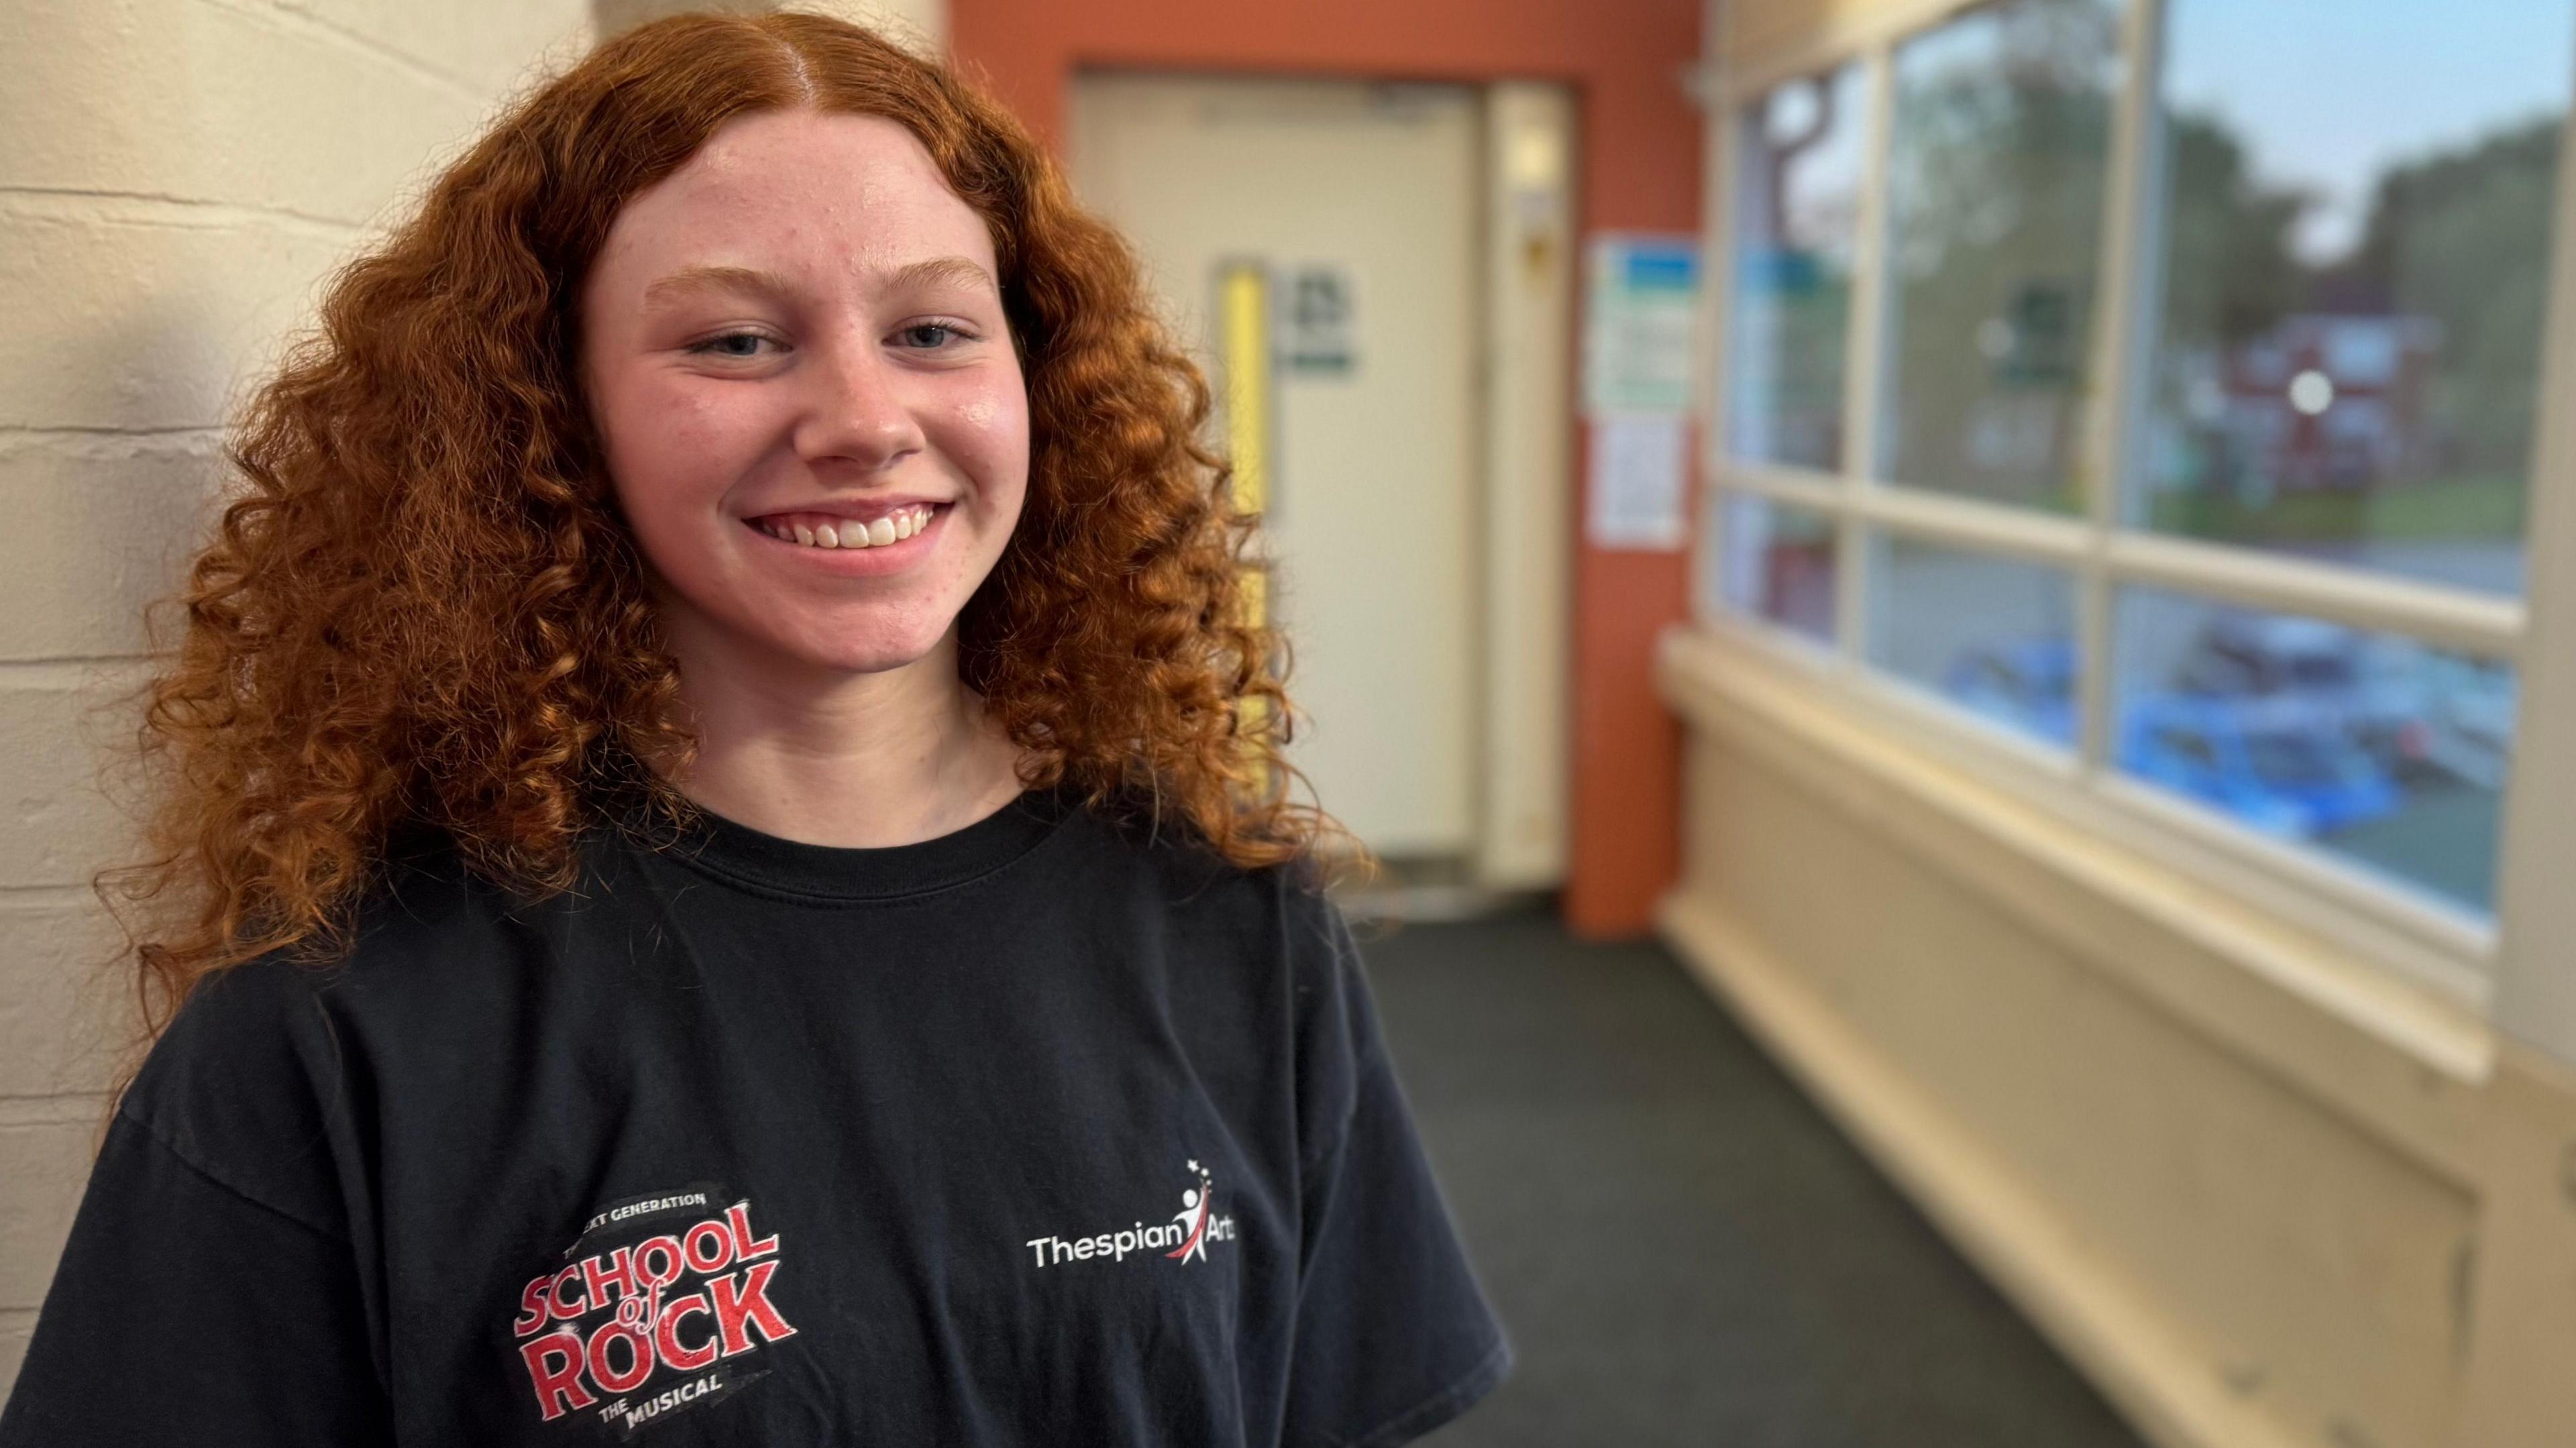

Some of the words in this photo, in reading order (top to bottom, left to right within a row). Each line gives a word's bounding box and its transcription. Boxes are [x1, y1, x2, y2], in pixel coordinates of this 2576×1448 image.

[582, 1213, 608, 1234] EXT
[610, 1193, 706, 1221] GENERATION
[514, 1199, 780, 1337] SCHOOL
[1026, 1221, 1182, 1268] Thespian
[616, 1278, 665, 1335] of
[519, 1260, 798, 1422] ROCK
[598, 1398, 629, 1423] THE
[625, 1374, 722, 1429] MUSICAL
